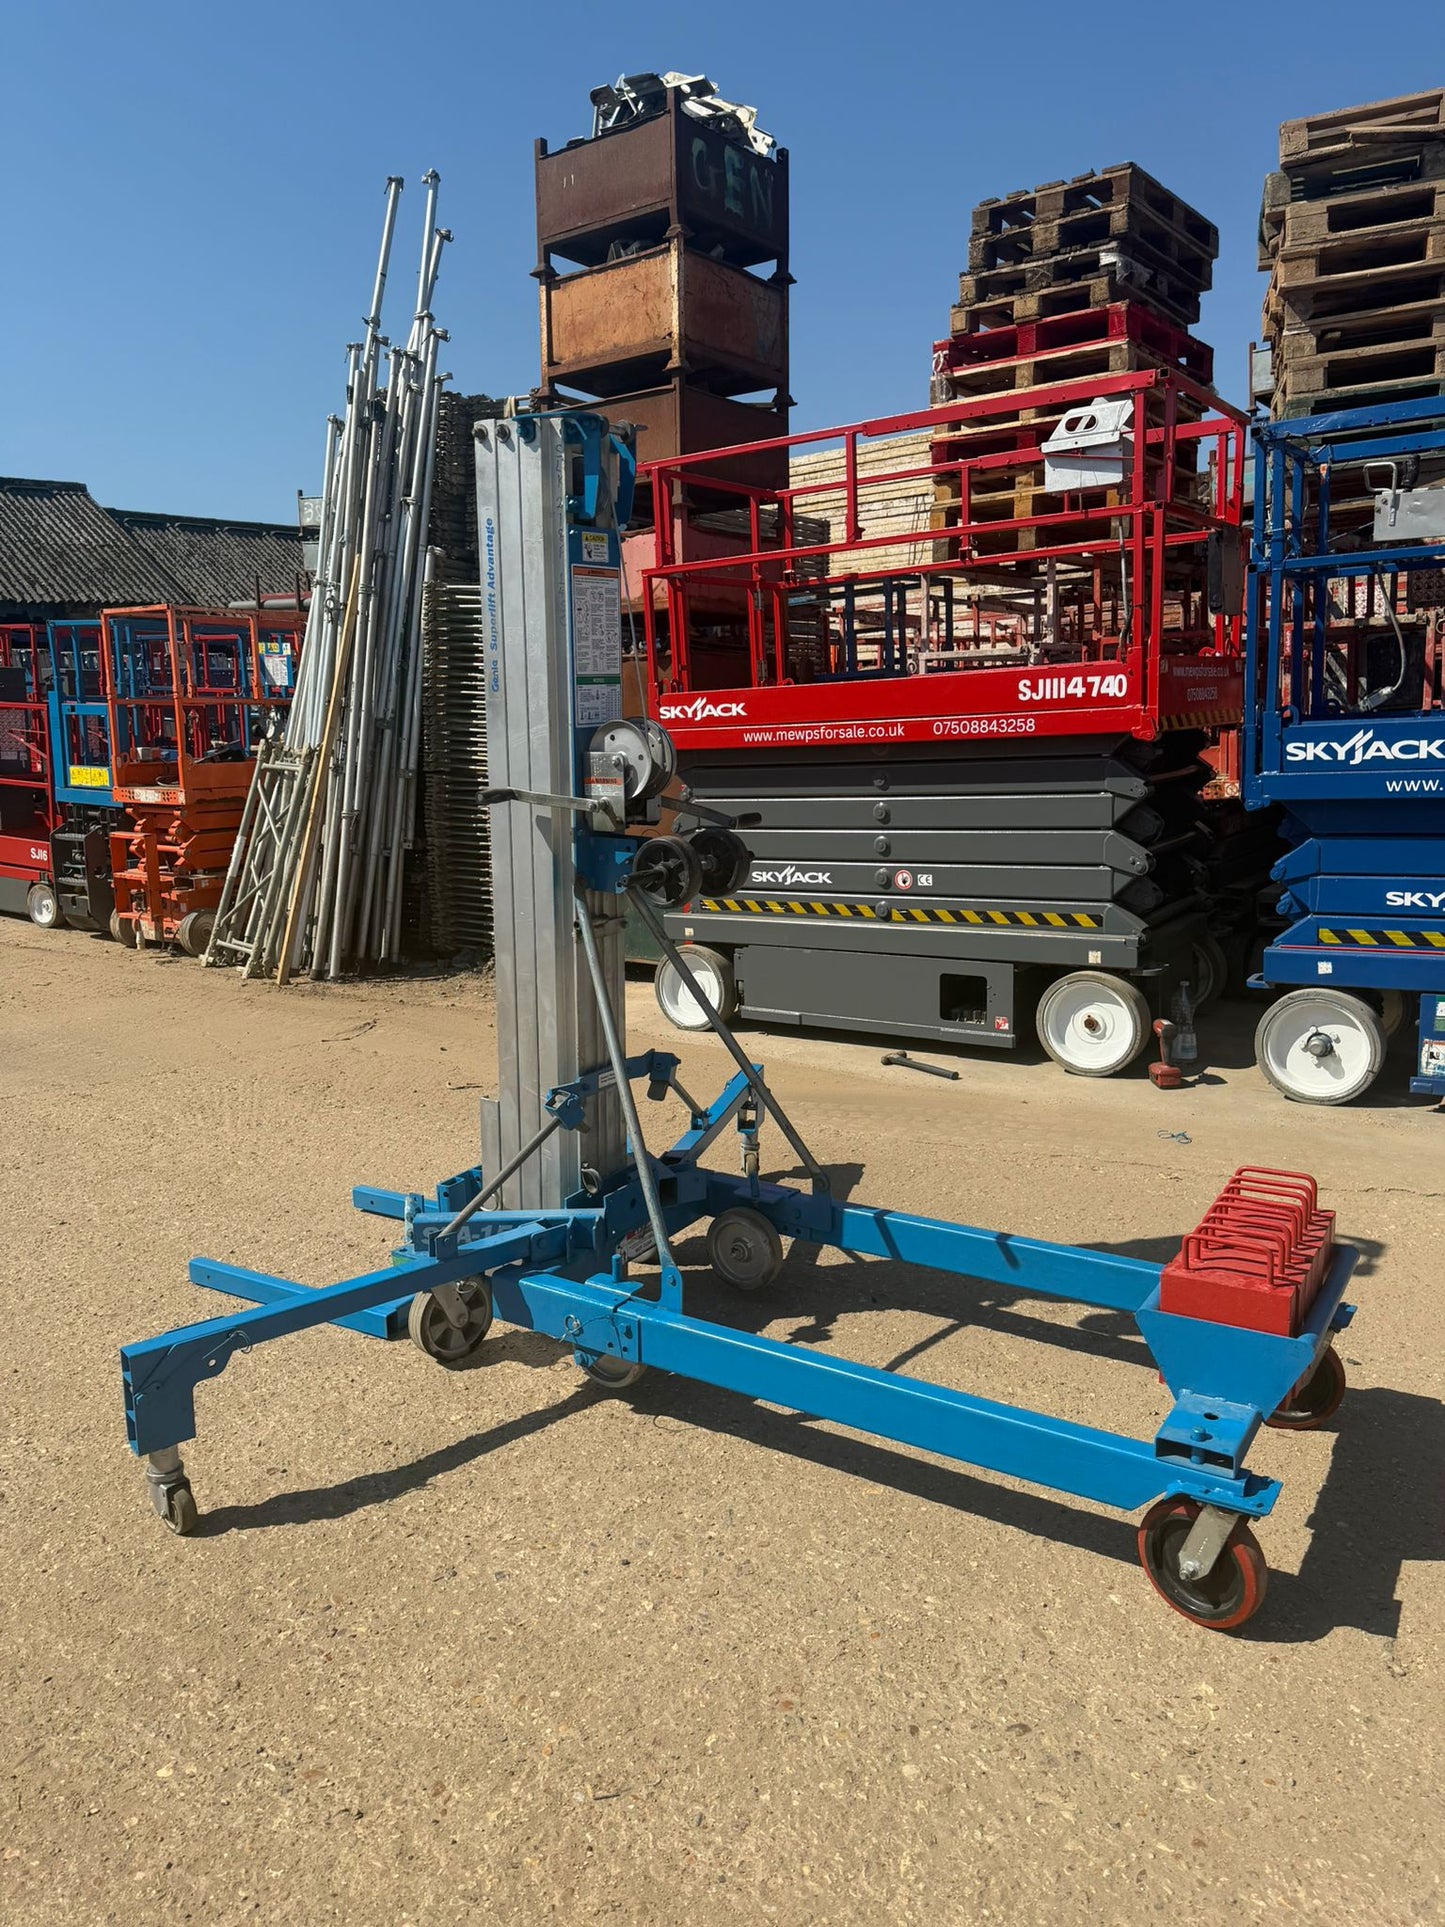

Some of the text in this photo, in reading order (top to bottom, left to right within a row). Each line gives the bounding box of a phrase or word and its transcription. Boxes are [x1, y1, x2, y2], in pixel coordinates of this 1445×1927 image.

[485, 518, 495, 590] Advantage
[487, 593, 497, 650] Superlift
[659, 697, 748, 722] SKYJACK
[743, 717, 1036, 744] www.mewpsforsale.co.uk 07508843258
[1286, 729, 1445, 765] SKYJACK
[1386, 779, 1444, 792] www.
[751, 865, 833, 886] SKYJACK
[1385, 891, 1445, 912] SKY
[421, 1224, 514, 1245] SA-1
